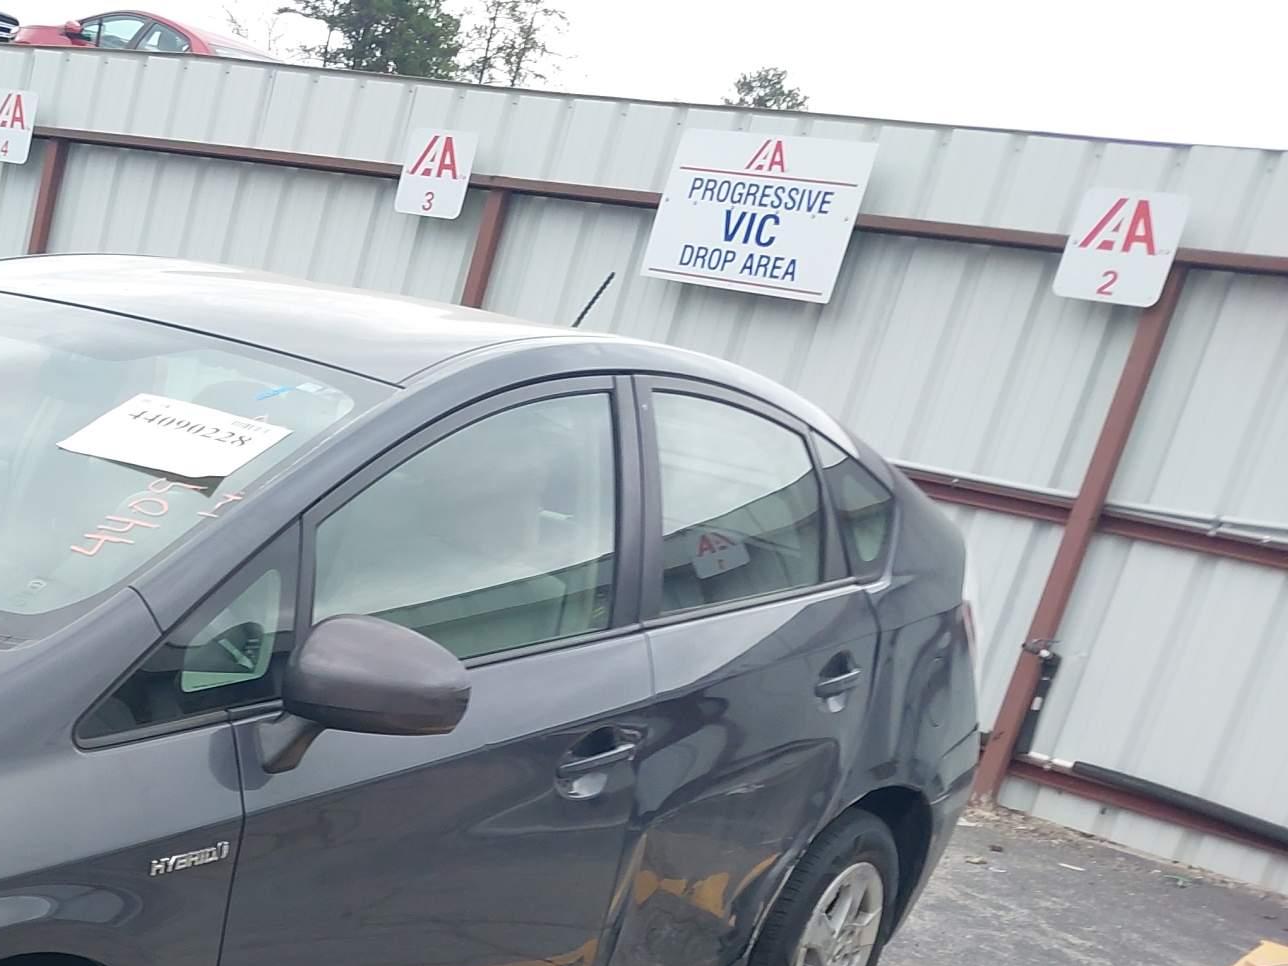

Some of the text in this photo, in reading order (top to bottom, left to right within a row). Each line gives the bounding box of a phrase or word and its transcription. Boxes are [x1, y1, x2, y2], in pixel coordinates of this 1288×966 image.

[0, 140, 9, 157] 4
[421, 191, 435, 211] 3
[688, 176, 835, 215] PROGRESSIVE
[722, 209, 781, 248] VIC
[679, 244, 737, 271] DROP
[739, 252, 799, 282] AREA
[1095, 270, 1119, 296] 2
[128, 409, 253, 447] 44090228
[150, 841, 231, 876] HYBRID
